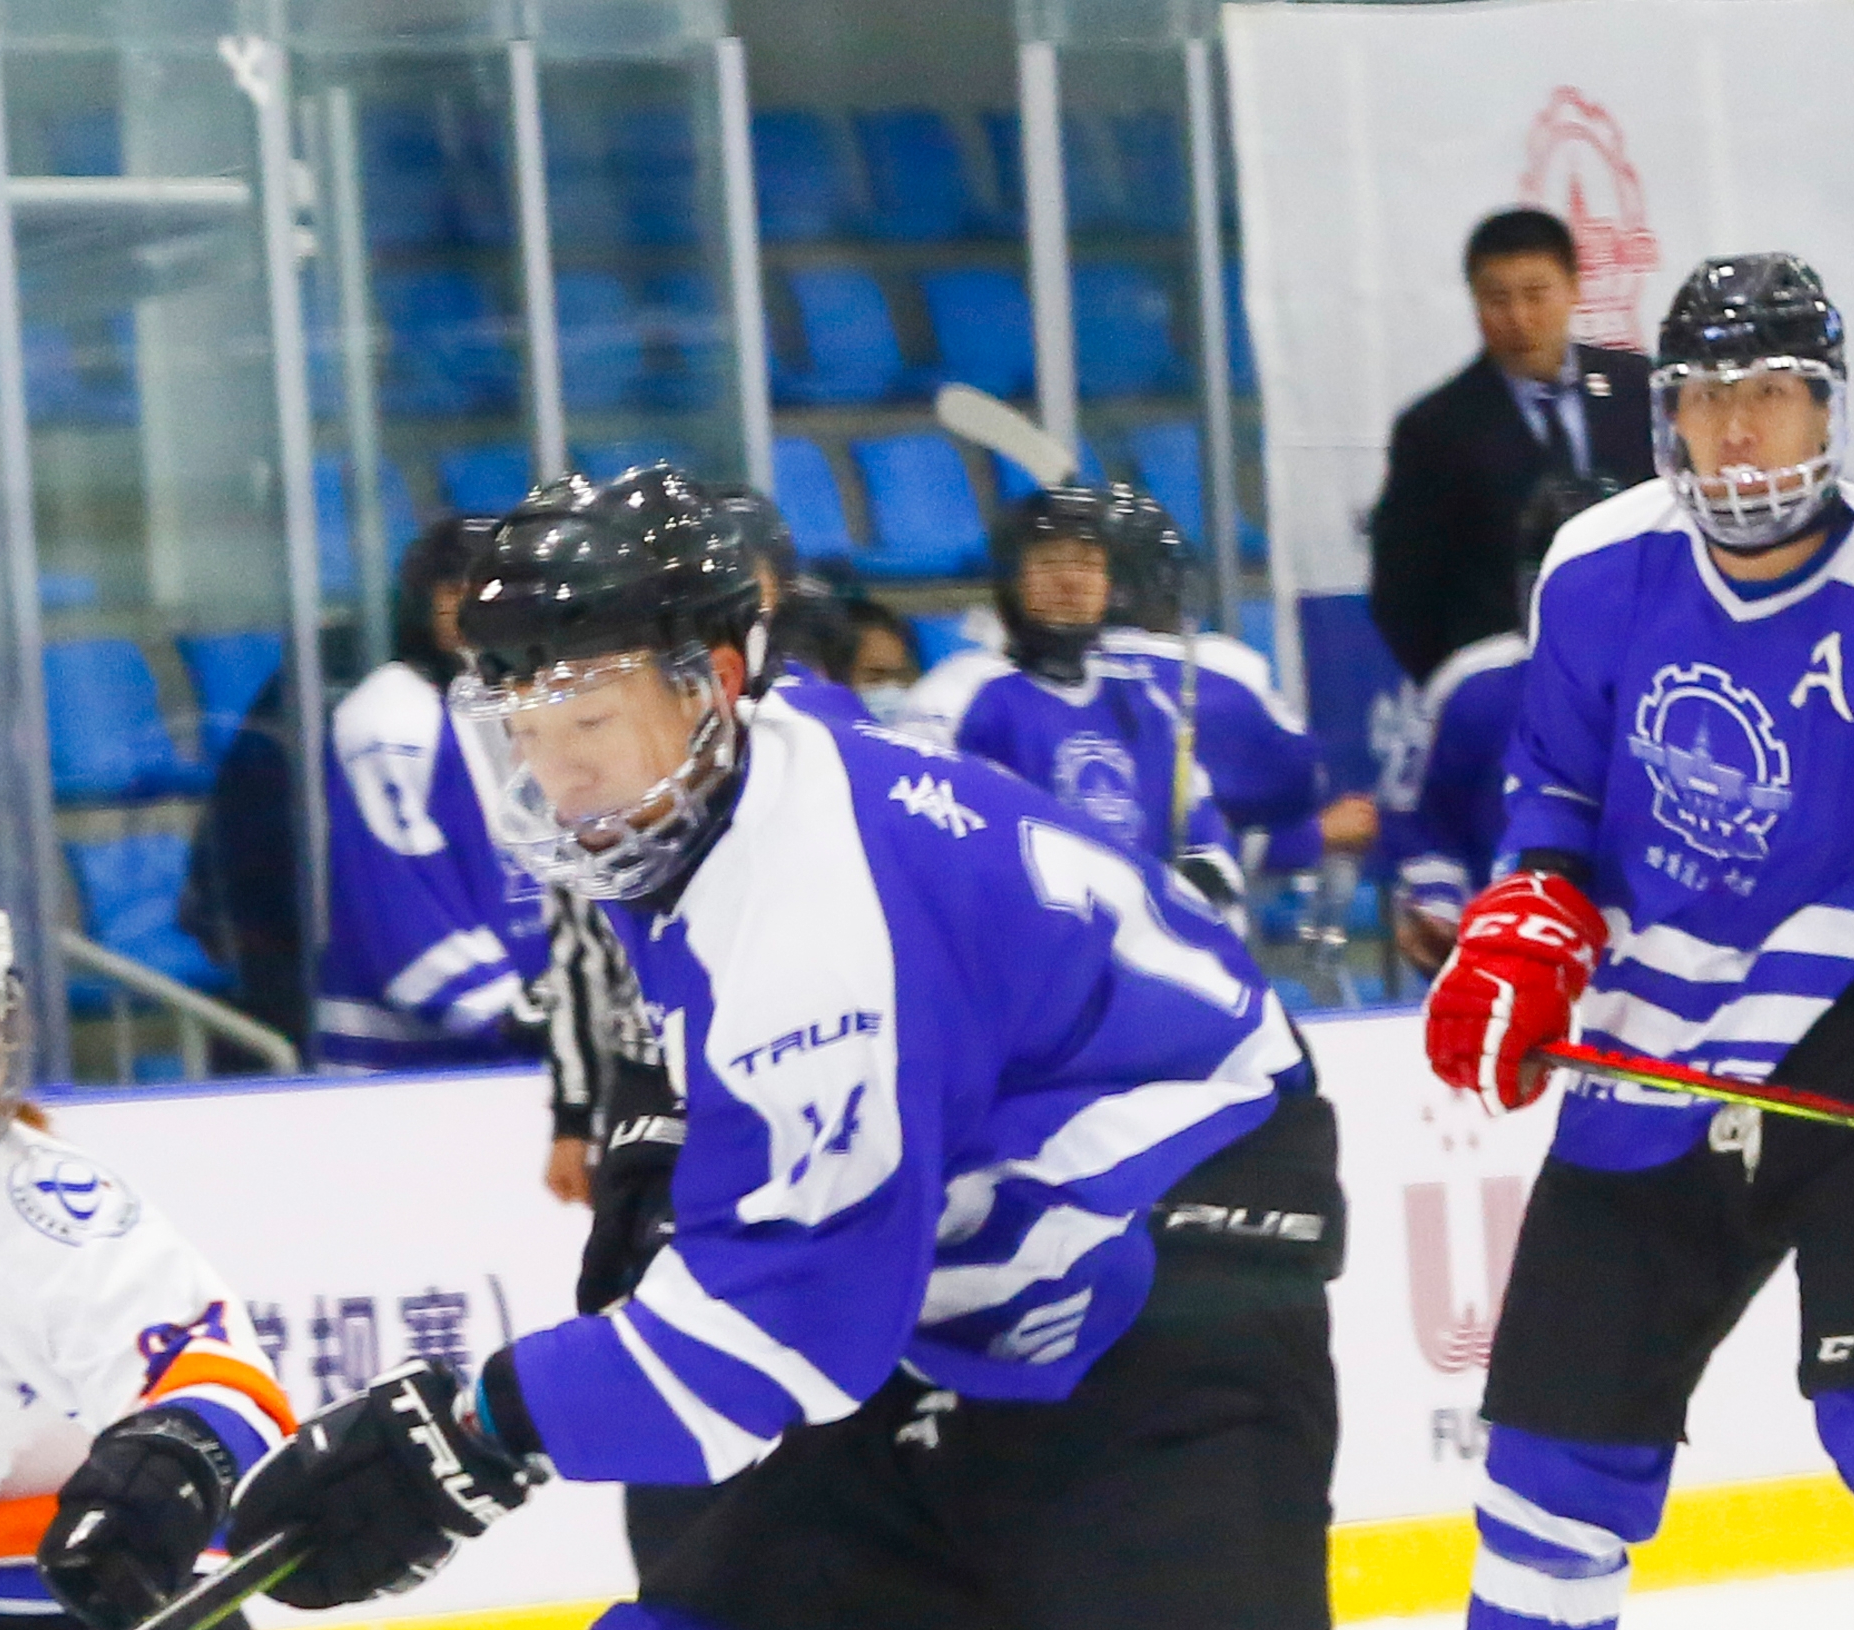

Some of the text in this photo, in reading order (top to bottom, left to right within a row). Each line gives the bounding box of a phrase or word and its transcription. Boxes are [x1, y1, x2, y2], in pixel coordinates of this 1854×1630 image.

[1790, 631, 1853, 724] A
[728, 1011, 883, 1077] TRUE
[1152, 1202, 1326, 1242] RUE
